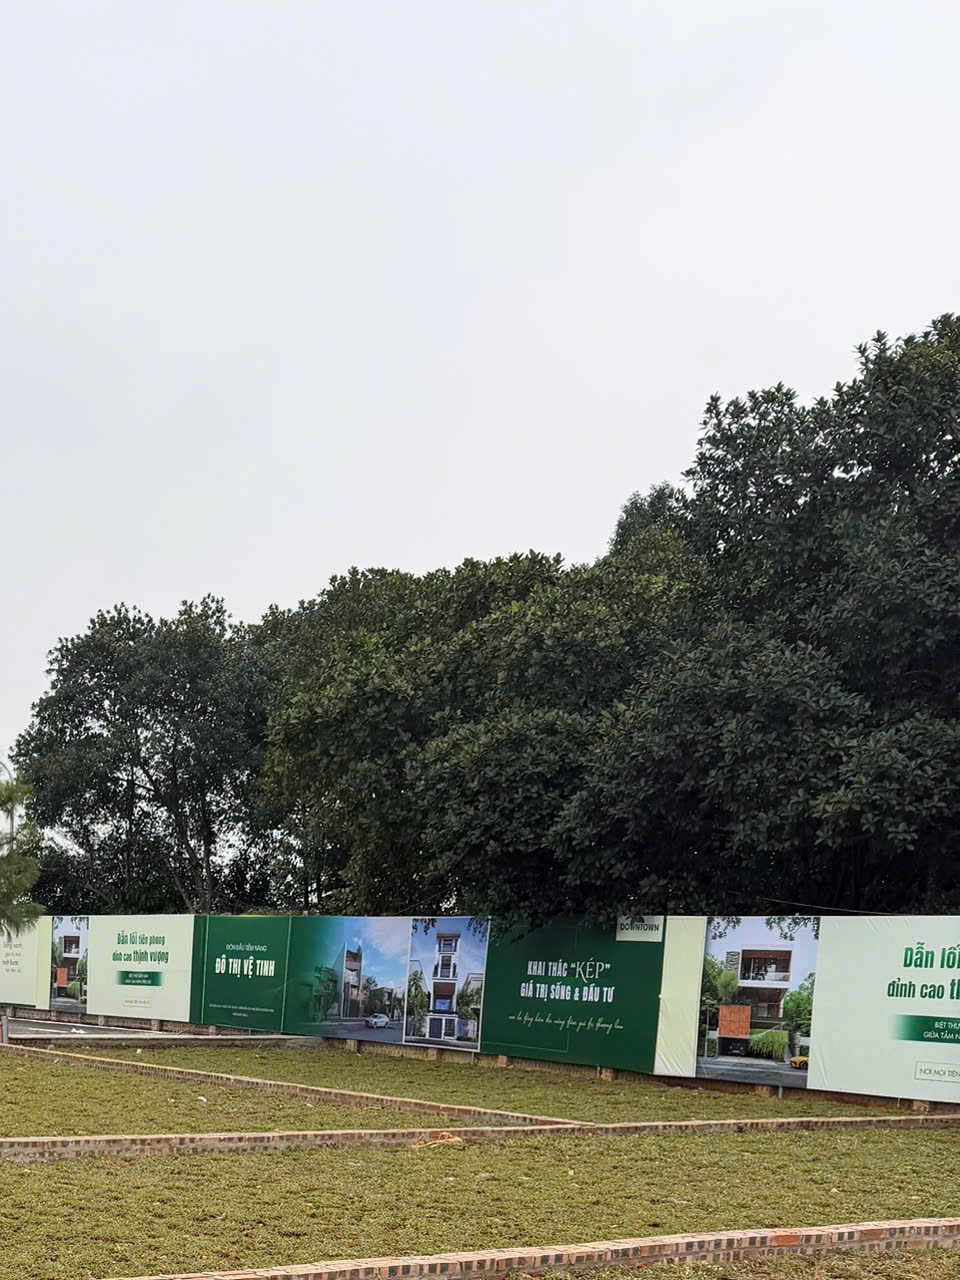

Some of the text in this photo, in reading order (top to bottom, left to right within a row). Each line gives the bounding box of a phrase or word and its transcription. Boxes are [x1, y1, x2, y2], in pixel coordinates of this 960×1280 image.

[620, 922, 660, 931] DOWNTOWN
[903, 941, 935, 968] Dẫn
[215, 954, 275, 978] ĐÔ THỊ VỆ TINH
[527, 961, 546, 976] KHAI
[548, 959, 568, 977] THÁC
[520, 980, 534, 998] GIÁ
[535, 983, 548, 1002] TRỊ
[550, 981, 572, 1000] SỐNG
[573, 987, 580, 1001] &
[602, 986, 616, 1003] TƯ
[887, 977, 916, 998] đỉnh
[920, 984, 945, 999] cao
